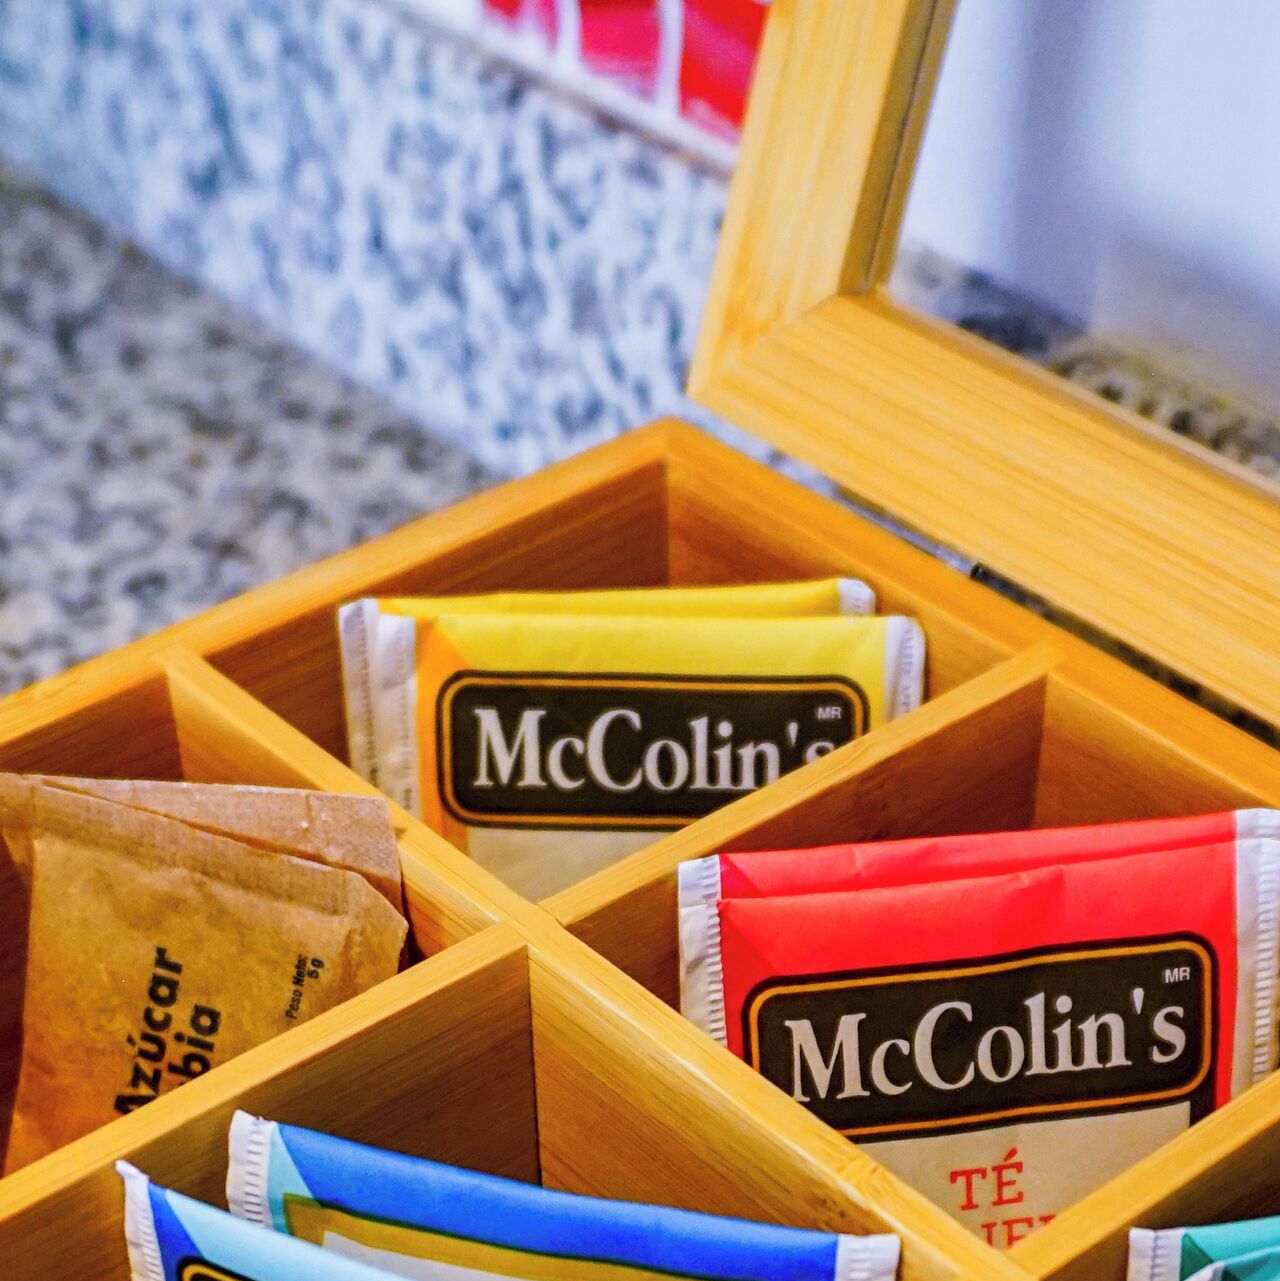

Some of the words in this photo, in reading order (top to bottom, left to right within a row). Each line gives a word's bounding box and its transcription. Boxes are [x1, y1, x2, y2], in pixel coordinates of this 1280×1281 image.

[818, 706, 841, 719] MR
[1164, 966, 1191, 983] MR
[167, 1004, 221, 1086] bia
[785, 988, 1186, 1102] McColin's
[950, 1147, 1024, 1211] TÉ
